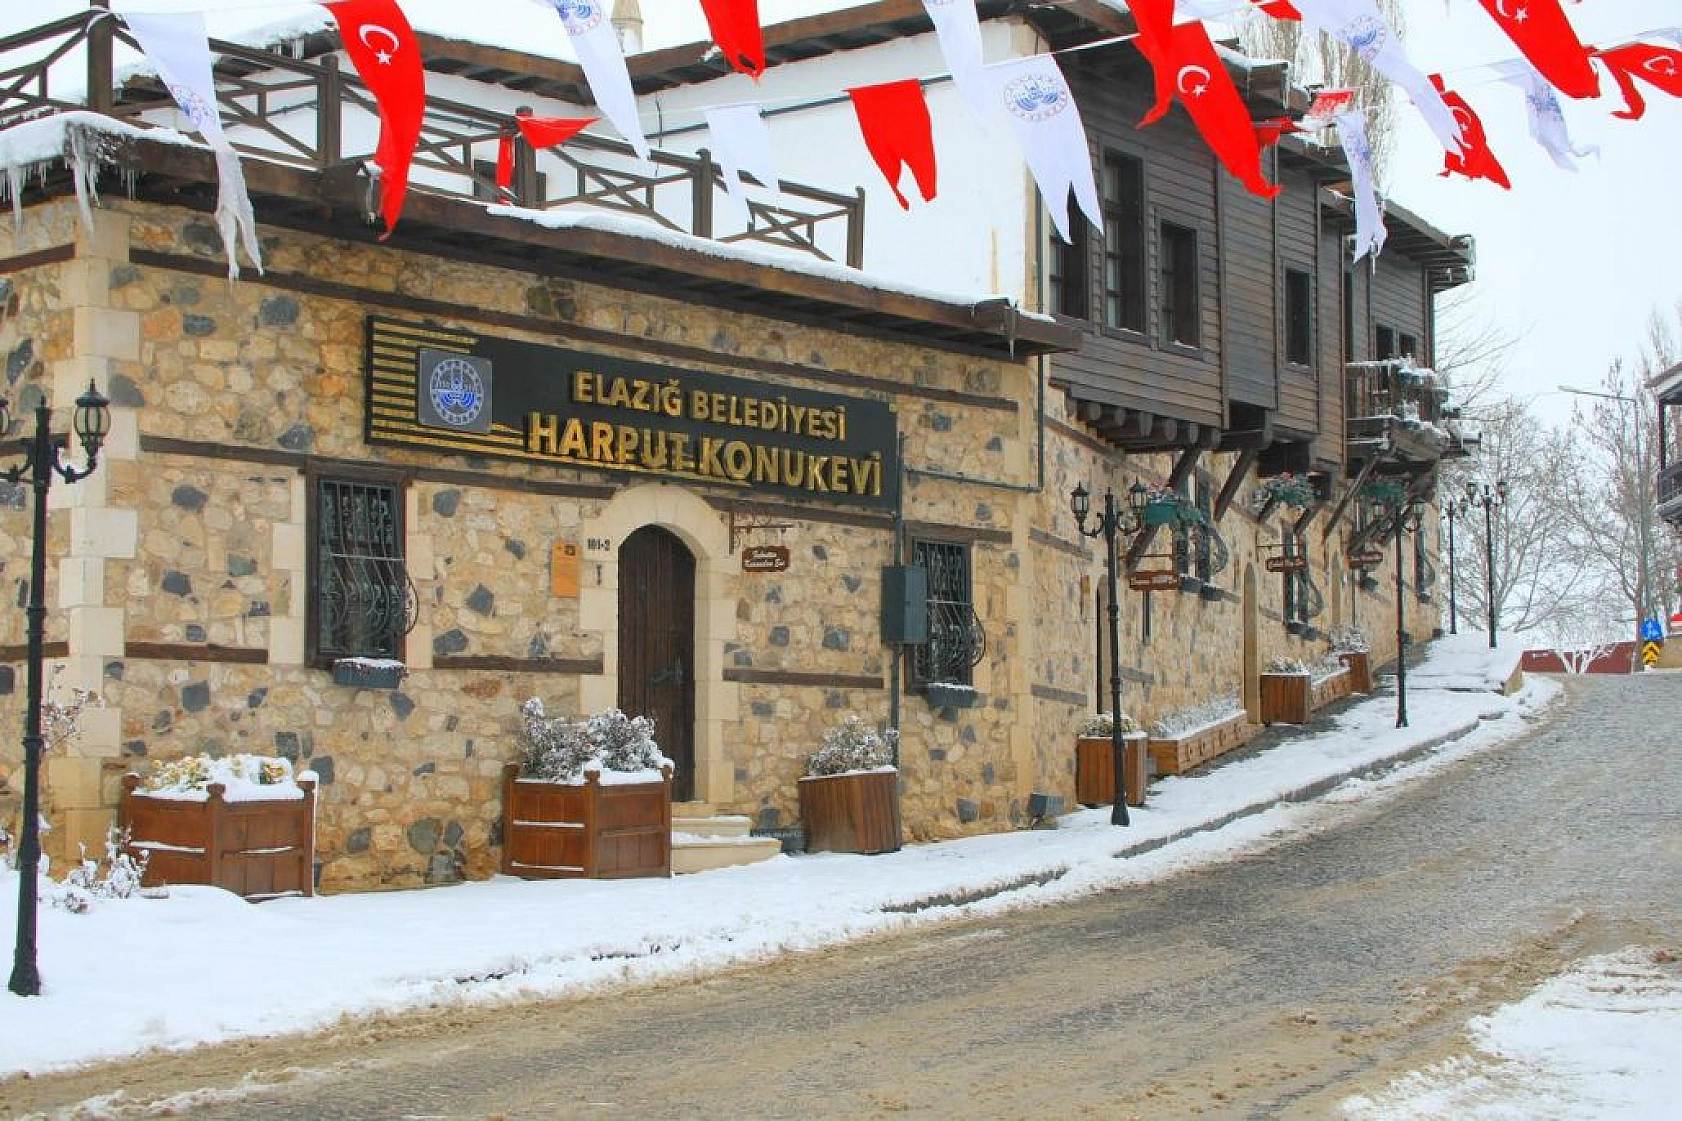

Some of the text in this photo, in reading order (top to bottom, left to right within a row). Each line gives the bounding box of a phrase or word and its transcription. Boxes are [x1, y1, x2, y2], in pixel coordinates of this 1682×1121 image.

[573, 370, 846, 441] ELAZIĞ BELEDİYESİ
[527, 411, 882, 497] HARPUT KONUKEVİ
